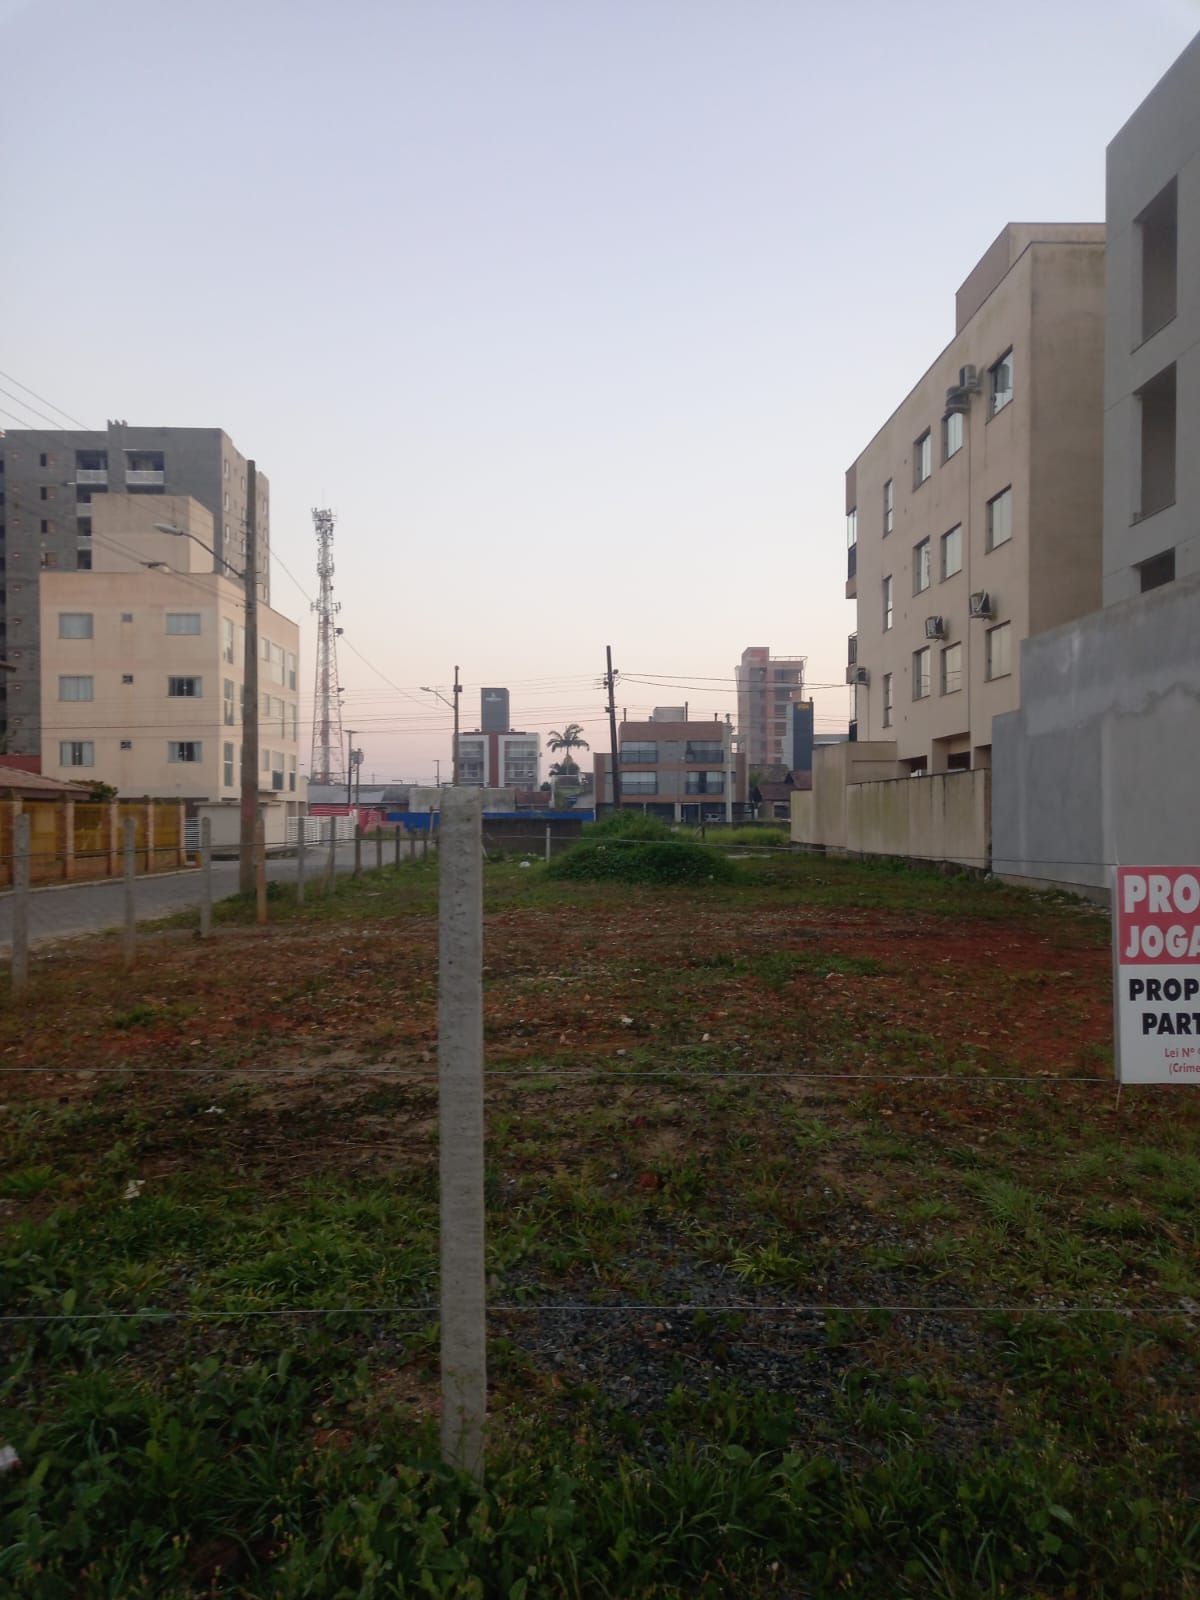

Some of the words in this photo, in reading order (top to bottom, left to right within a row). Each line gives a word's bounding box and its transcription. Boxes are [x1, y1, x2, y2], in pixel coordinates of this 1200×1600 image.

[1123, 874, 1200, 914] PRO
[1128, 978, 1199, 1001] PROP
[1142, 1012, 1200, 1035] PART
[1164, 1047, 1178, 1058] Lei
